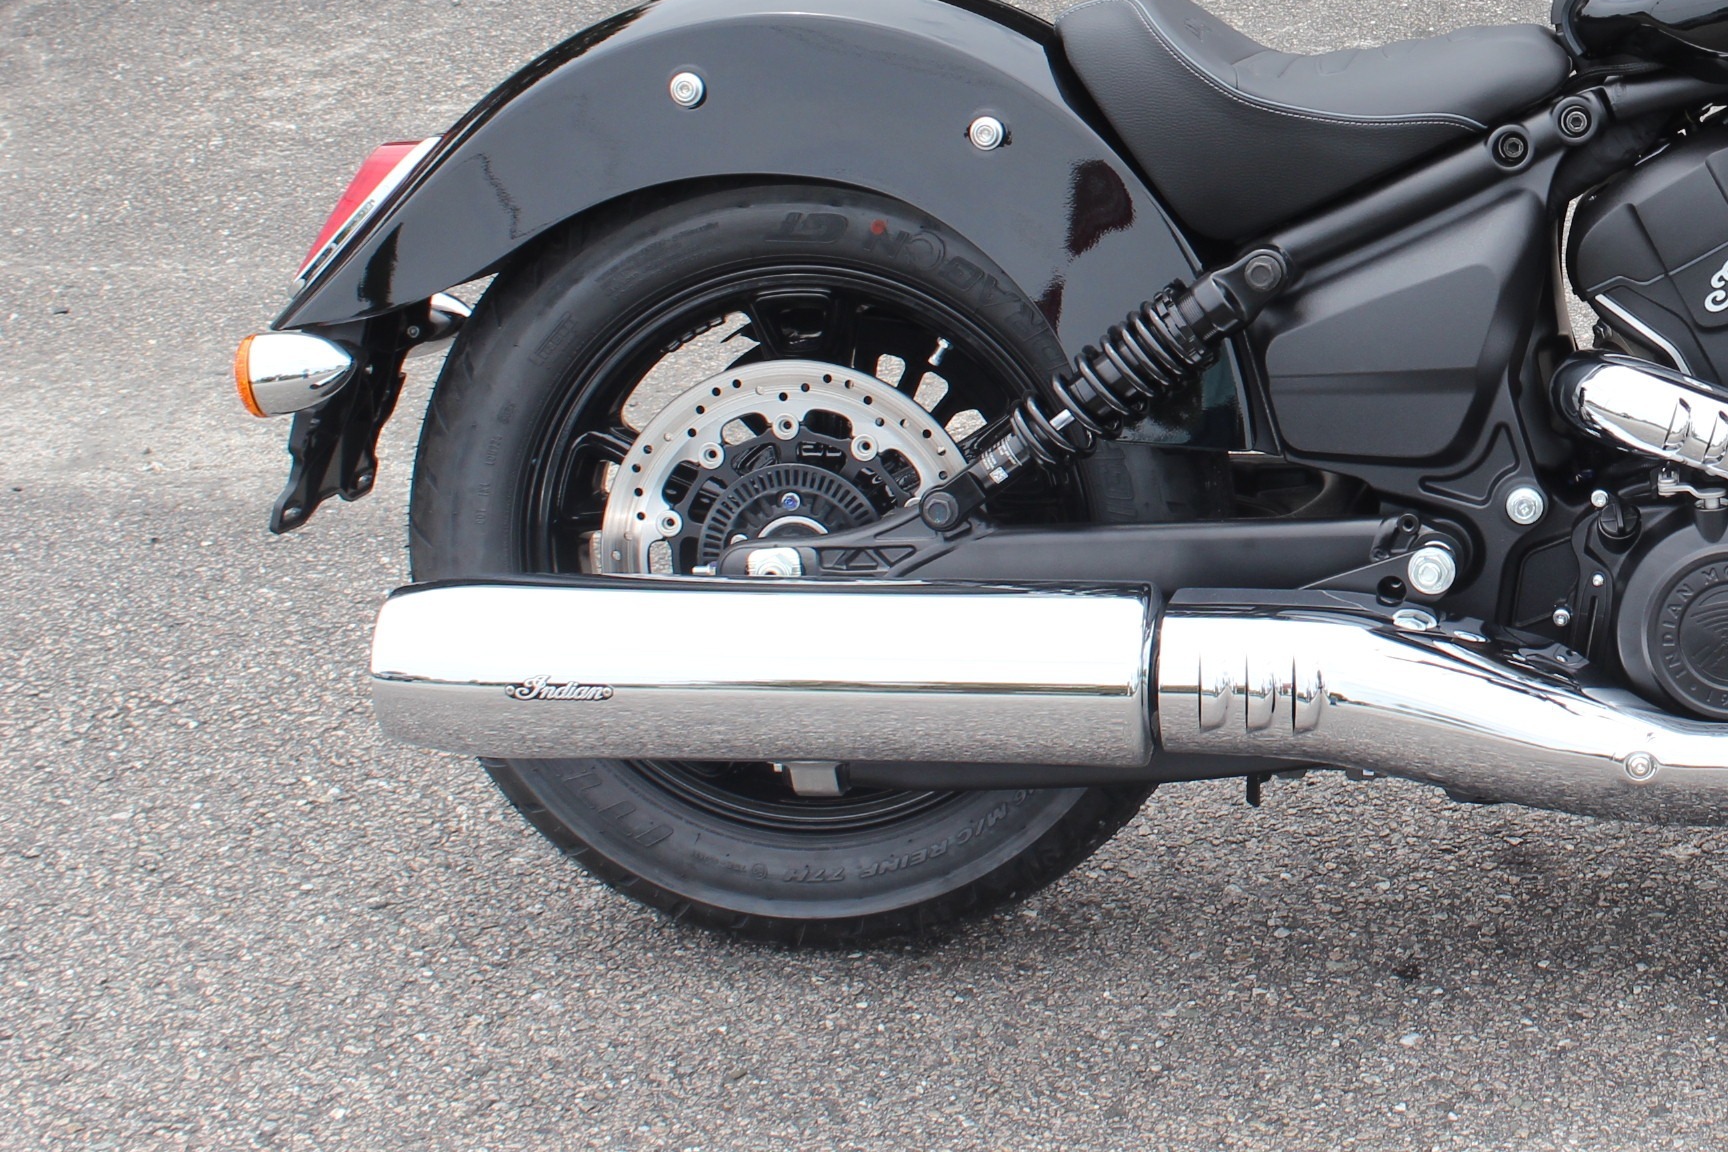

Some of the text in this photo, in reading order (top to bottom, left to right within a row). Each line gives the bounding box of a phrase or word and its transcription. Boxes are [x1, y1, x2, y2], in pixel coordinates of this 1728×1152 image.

[1661, 585, 1694, 679] INDIAN
[514, 674, 605, 701] Indian
[858, 837, 950, 881] REINF
